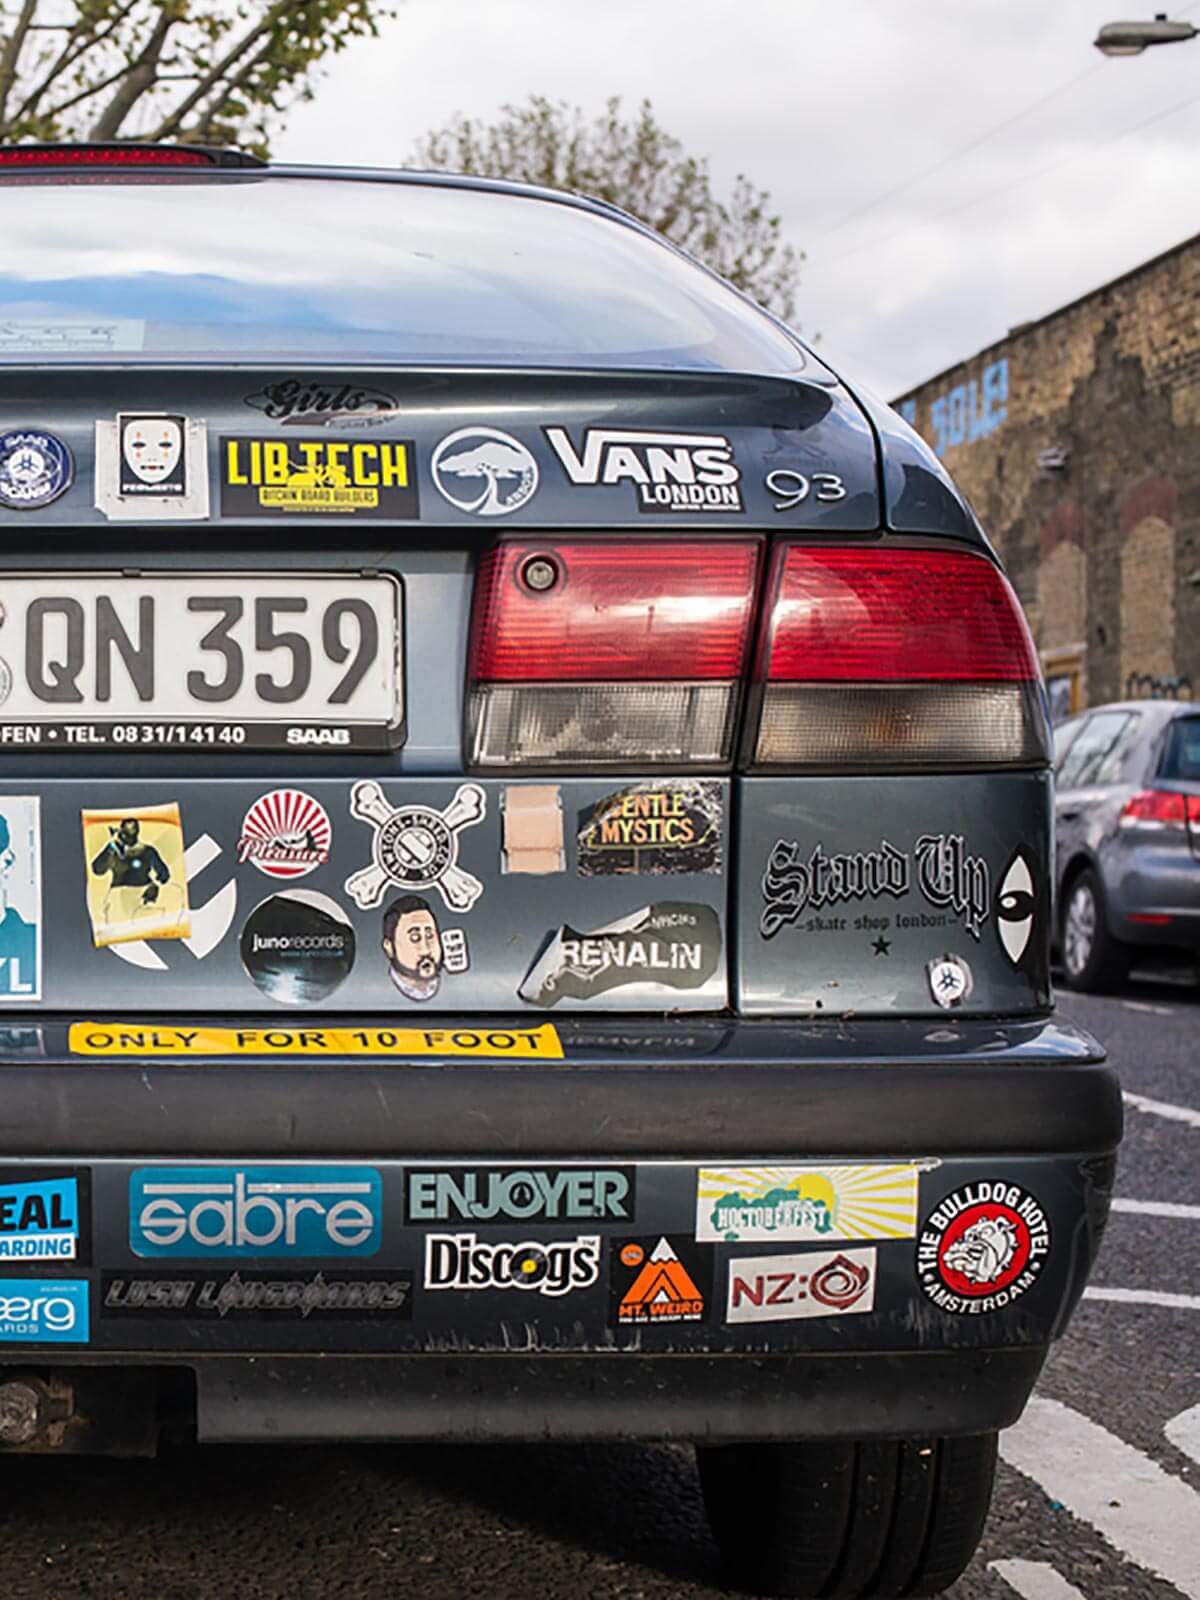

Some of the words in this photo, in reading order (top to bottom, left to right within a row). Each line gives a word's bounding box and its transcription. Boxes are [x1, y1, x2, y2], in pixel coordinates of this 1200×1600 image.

[264, 380, 366, 418] Girls
[228, 441, 289, 485] LIB
[299, 443, 408, 487] TECH
[545, 428, 740, 485] VANS
[640, 484, 740, 504] LONDON
[766, 470, 847, 511] 93
[25, 595, 155, 703] QN
[186, 596, 379, 704] 359
[65, 726, 106, 743] TEL.
[286, 728, 351, 745] SAAB
[610, 793, 686, 817] ENTLE
[237, 837, 329, 863] Pleasure
[601, 817, 694, 843] MYSTICS
[760, 839, 909, 938] Stand
[915, 834, 990, 942] Up
[854, 914, 891, 930] shop
[85, 1031, 200, 1048] ONLY
[237, 1031, 327, 1048] FOR
[352, 1031, 398, 1048] 10
[424, 1033, 543, 1050] FOOT
[140, 1173, 374, 1246] sabre
[410, 1171, 629, 1219] ENJOYER
[928, 1182, 1021, 1231] BULLDOG
[1017, 1196, 1049, 1260] HOTEL
[429, 1239, 598, 1292] Discogs
[918, 1231, 942, 1275] THE
[923, 1271, 1036, 1314] AMSTERDAM
